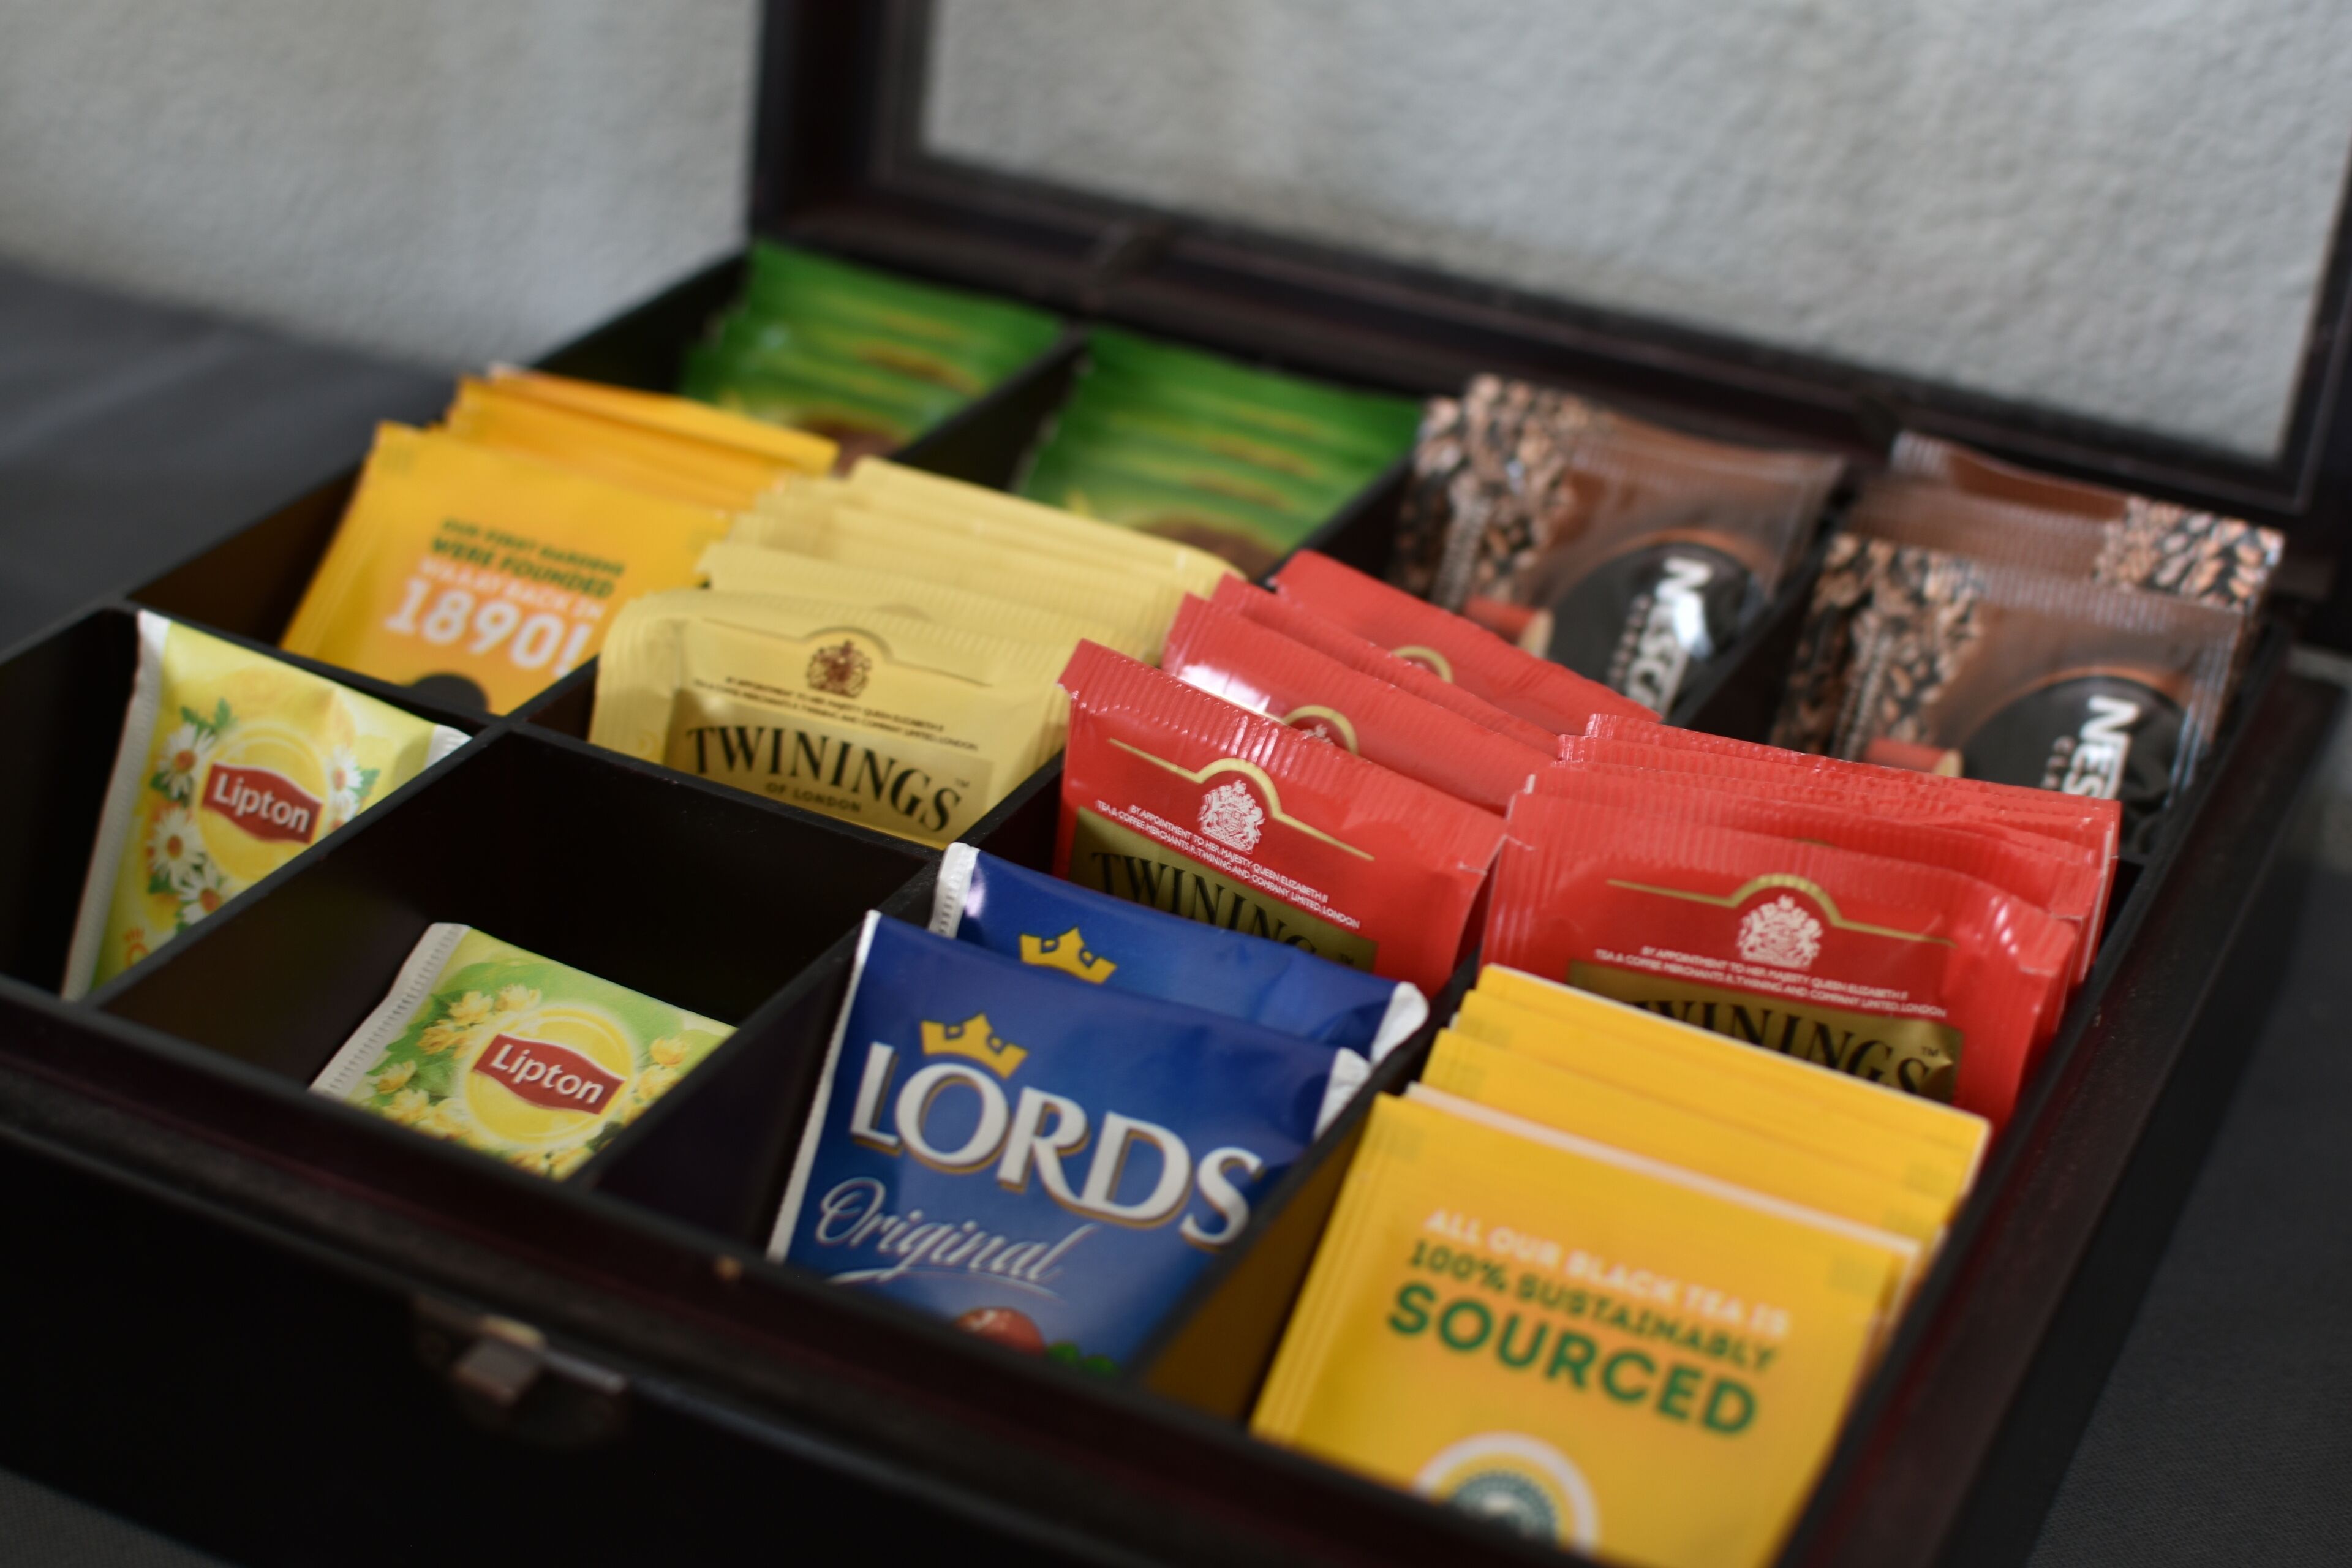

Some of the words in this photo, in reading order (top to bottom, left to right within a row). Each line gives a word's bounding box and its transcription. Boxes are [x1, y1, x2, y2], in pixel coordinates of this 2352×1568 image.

[385, 578, 592, 676] 1890!
[497, 554, 616, 600] FOUNDED
[211, 772, 312, 834] Lipton
[686, 725, 963, 833] TWININGS
[1096, 799, 1112, 813] TEA
[1118, 810, 1145, 829] COFFEE
[1144, 823, 1190, 851] MERCHANTS
[1197, 847, 1232, 870] TWINING
[1231, 865, 1251, 879] AND
[1251, 874, 1291, 897] COMPANY
[1321, 905, 1360, 929] LONDON
[1129, 805, 1142, 815] BY
[1139, 810, 1192, 840] APPOINTMENT
[1193, 833, 1205, 845] TO
[1205, 841, 1219, 854] HER
[1221, 848, 1253, 868] MAJESTY
[1253, 863, 1280, 882] QUEEN
[1280, 874, 1322, 900] ELIZABETH
[1624, 954, 1662, 970] COFFEE
[1663, 961, 1725, 981] MERCHANTS
[1735, 975, 1783, 992] TWINING
[1783, 984, 1807, 997] AND
[1808, 989, 1861, 1006] COMPANY
[1900, 1003, 1947, 1018] LONDON
[1655, 949, 1729, 970] APPOINTMENT
[1730, 962, 1744, 973] TO
[1746, 965, 1766, 976] HER
[1768, 969, 1811, 985] MAJESTY
[1811, 976, 1846, 992] QUEEN
[1847, 982, 1899, 1000] ELIZABETH
[489, 1043, 606, 1105] Lipton
[849, 1041, 1268, 1253] LORDS
[813, 1176, 1101, 1283] Original
[1422, 1207, 1482, 1246] ALL
[1486, 1224, 1561, 1269] OUR
[1563, 1246, 1679, 1305] BLACK
[1683, 1272, 1744, 1327] TEA
[1749, 1301, 1792, 1339] IS
[1407, 1238, 1508, 1294] 100%
[1515, 1272, 1779, 1374] SUSTAINABLY
[1384, 1279, 1760, 1438] SOURCED
